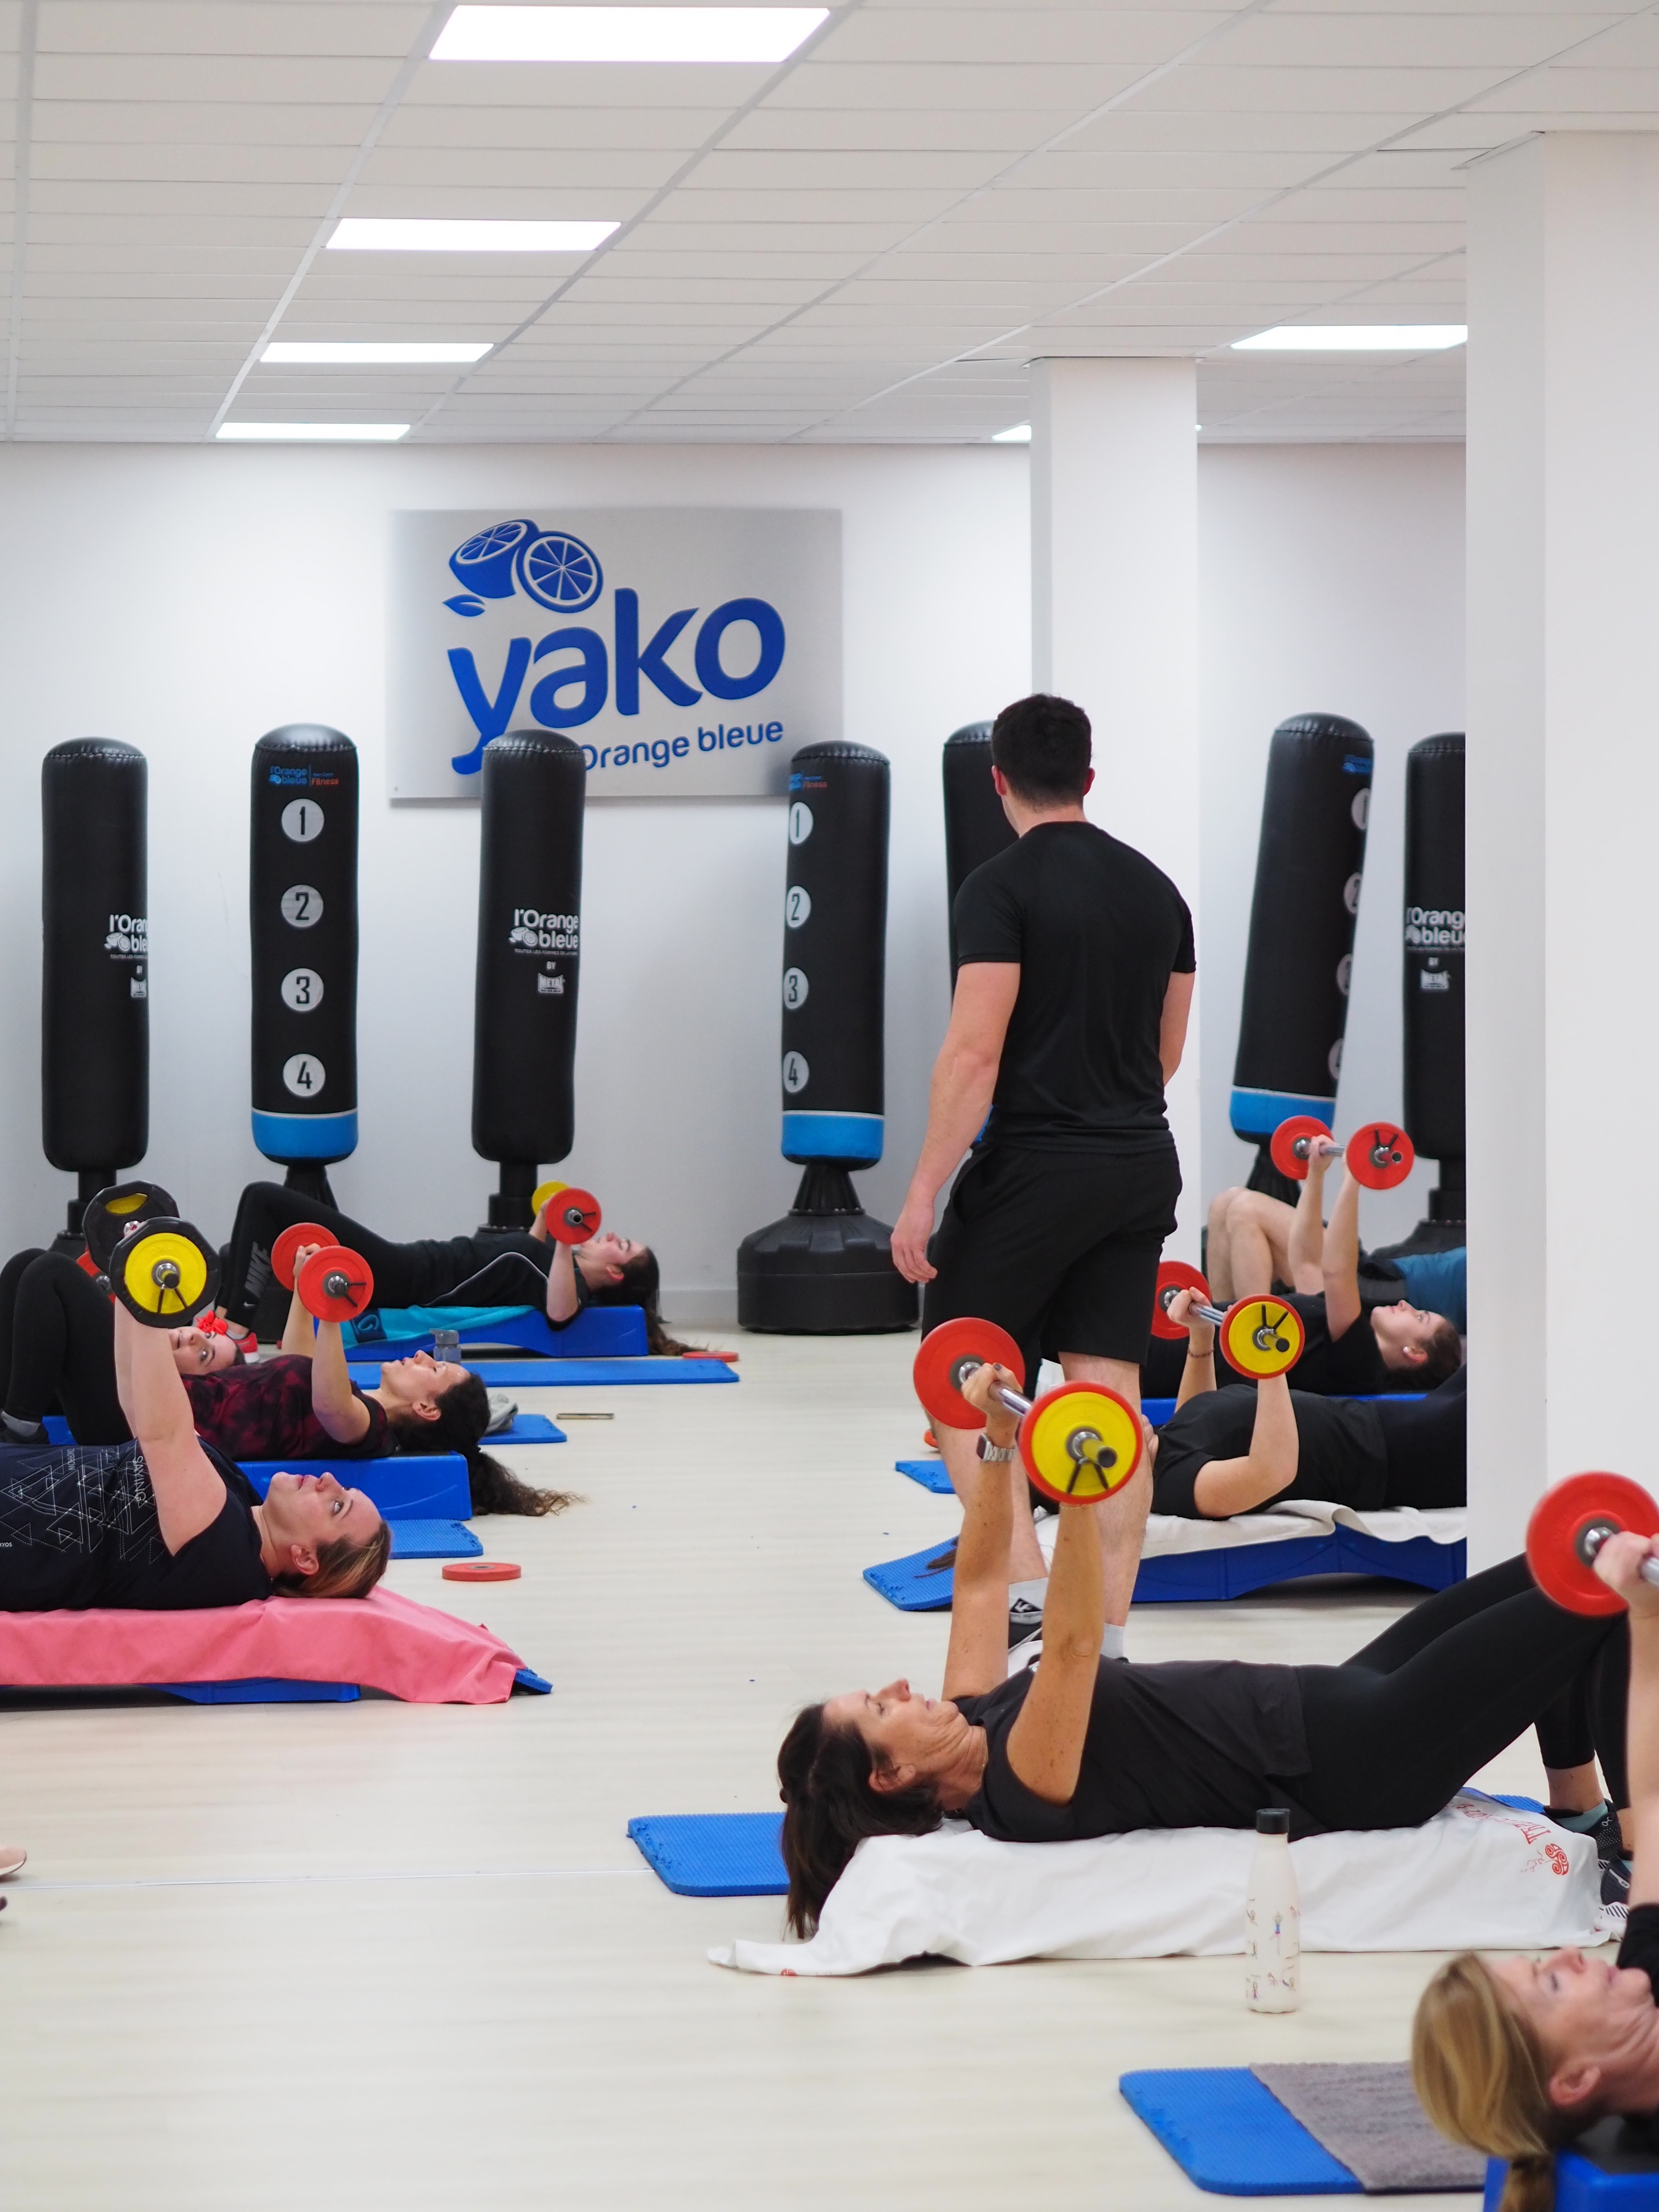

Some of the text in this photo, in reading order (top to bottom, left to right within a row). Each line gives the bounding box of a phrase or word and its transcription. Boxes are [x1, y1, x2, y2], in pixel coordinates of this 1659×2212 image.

[447, 587, 785, 775] yako
[697, 721, 783, 751] bleue
[282, 775, 307, 784] bleue
[300, 806, 305, 835] 1
[796, 809, 800, 837] 1
[295, 892, 309, 920] 2
[792, 893, 800, 920] 2
[1407, 906, 1465, 930] l'Orang
[109, 914, 147, 932] l'Oran
[515, 909, 578, 934] l'Orange
[1422, 926, 1465, 945] bleu
[539, 929, 578, 949] bleue
[547, 961, 556, 969] BY
[296, 975, 310, 1004] 3
[789, 974, 798, 1002] 3
[297, 1061, 312, 1089] 4
[788, 1058, 798, 1085] 4
[244, 1241, 272, 1298] NIKE
[133, 1455, 146, 1502] SAYING
